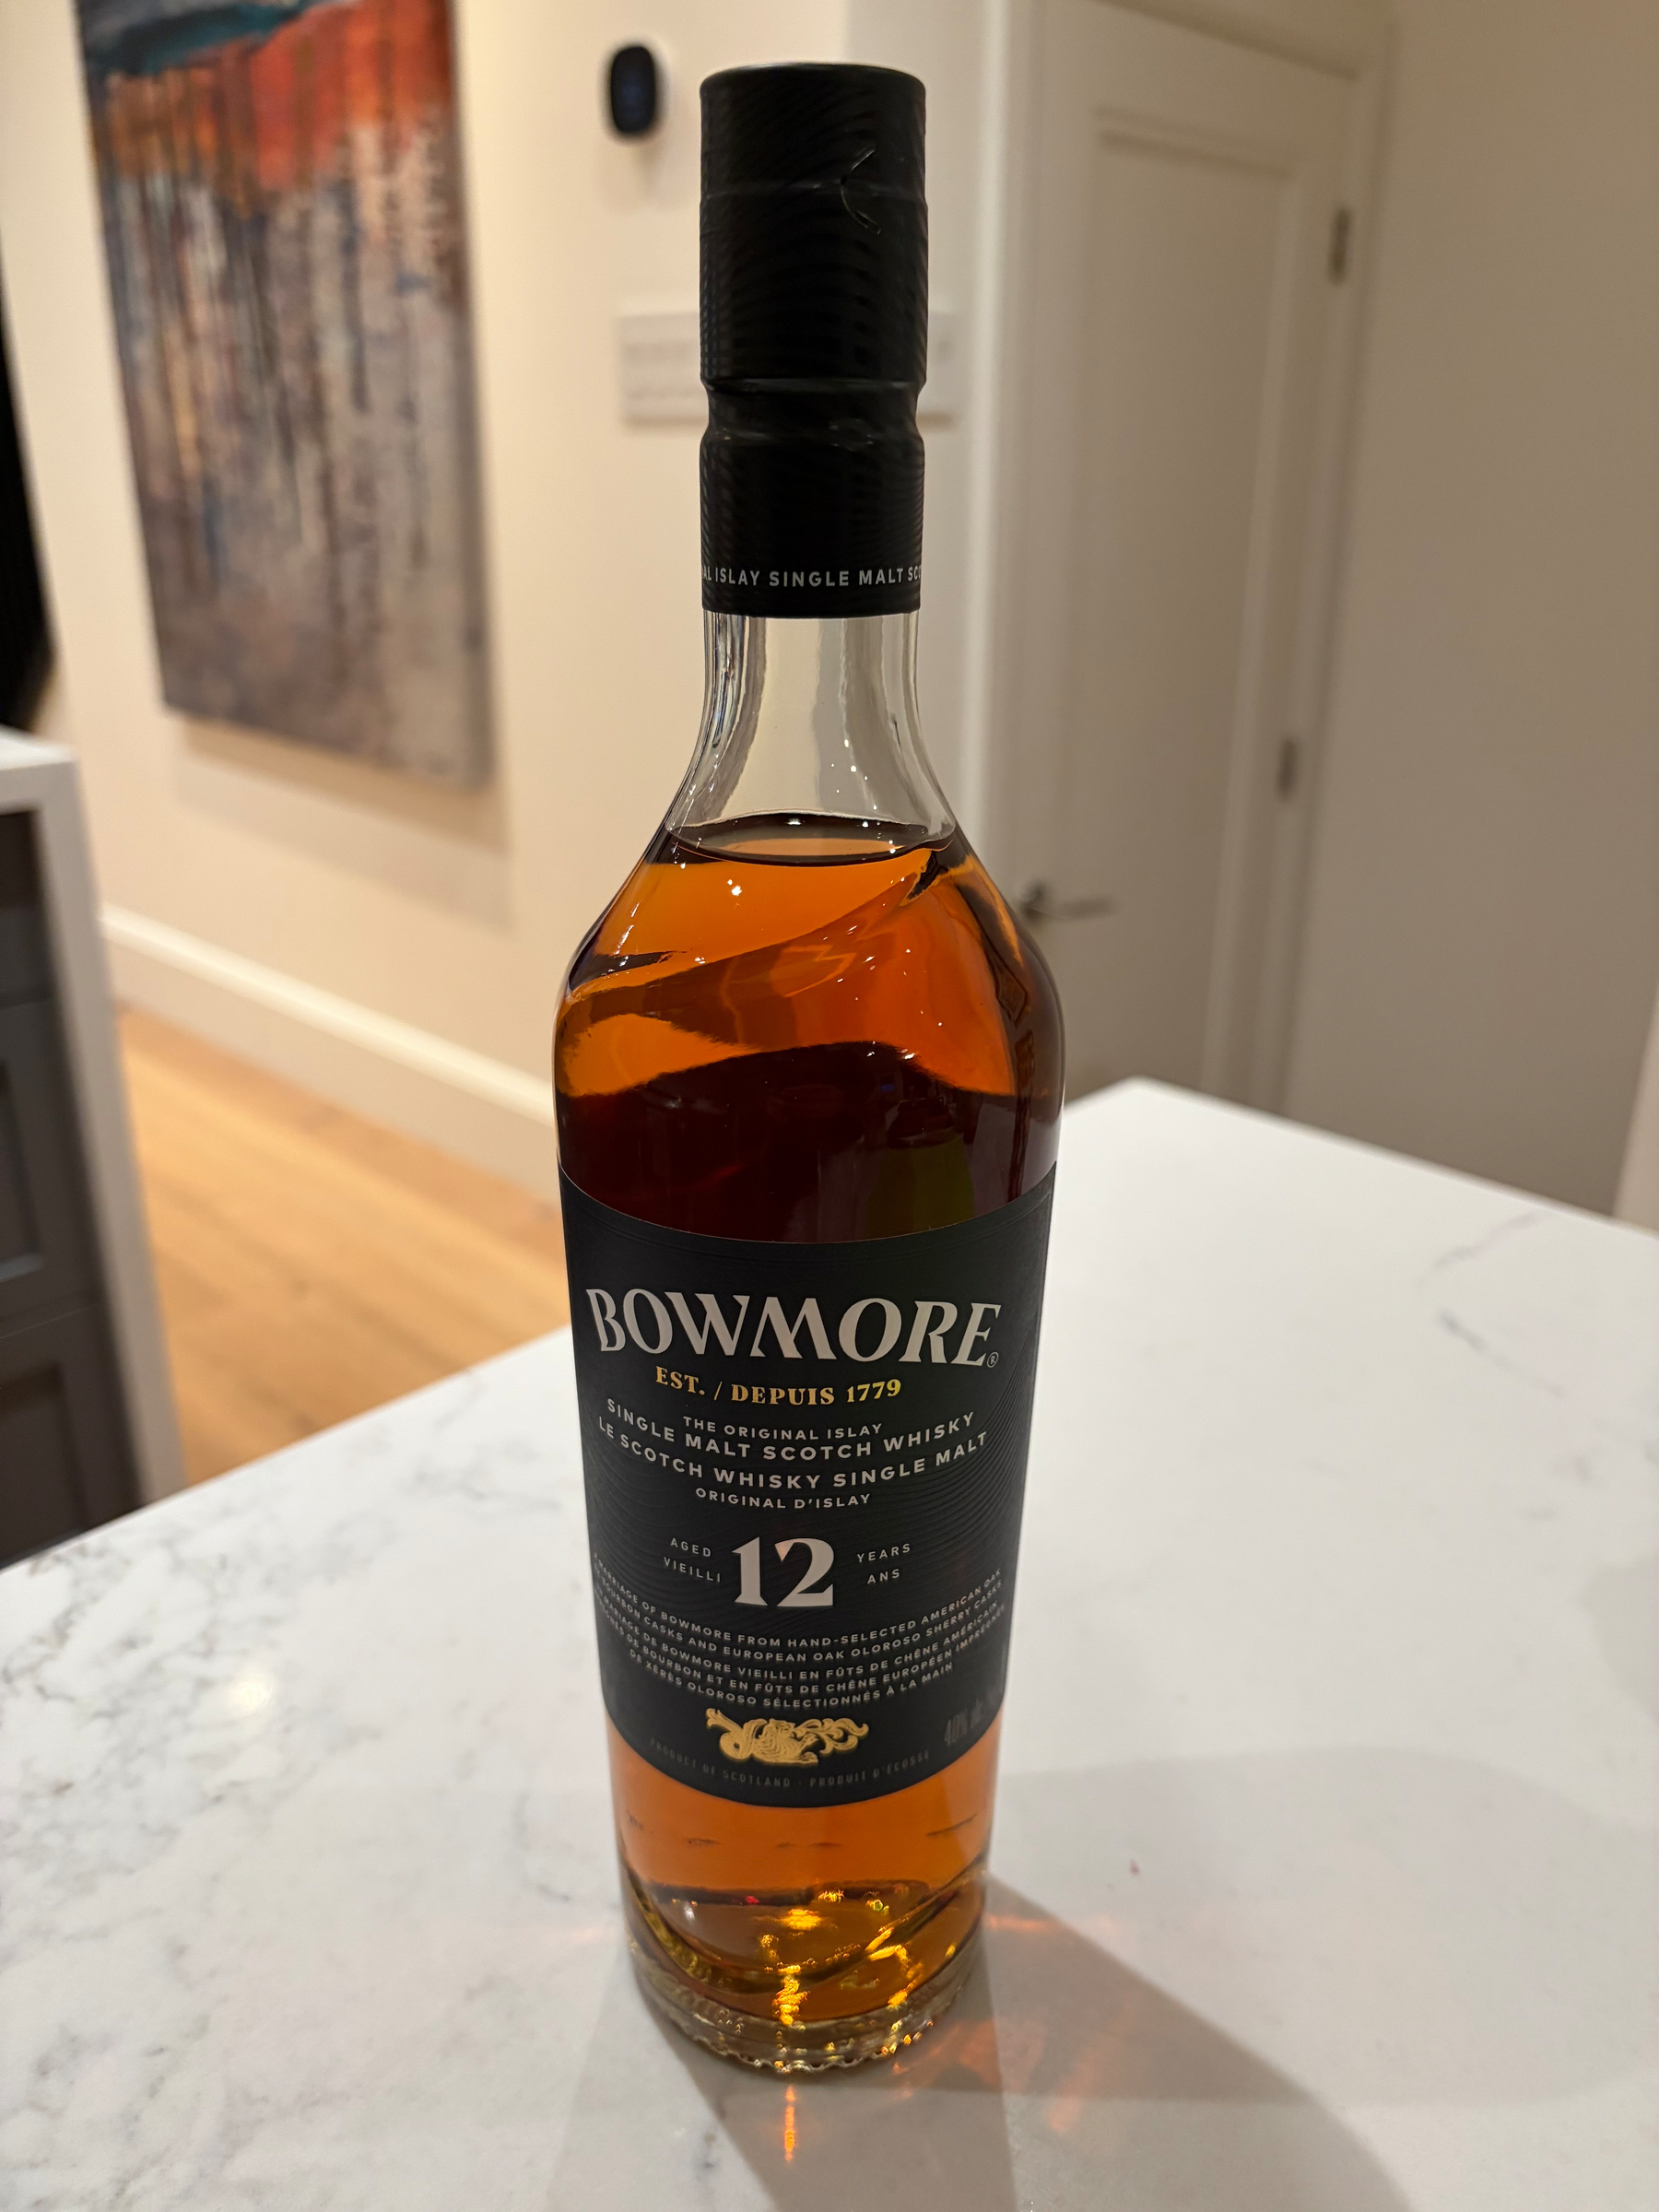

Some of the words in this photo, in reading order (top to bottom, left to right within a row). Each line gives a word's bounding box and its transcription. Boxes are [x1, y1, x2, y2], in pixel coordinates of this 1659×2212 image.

[715, 568, 760, 586] ISLAY
[770, 571, 849, 587] SINGLE
[859, 568, 904, 585] MALT
[655, 1365, 705, 1395] EST.
[731, 1383, 835, 1406] DEPUIS
[846, 1379, 901, 1403] 1779
[599, 1416, 615, 1440] LE
[620, 1433, 702, 1478] SCOTCH
[713, 1467, 820, 1489] WHISKY
[833, 1458, 925, 1488] SINGLE
[935, 1431, 987, 1466] MALT
[606, 1398, 675, 1443] SINGLE
[685, 1432, 750, 1458] MALT
[763, 1441, 871, 1462] SCOTCH
[883, 1411, 974, 1453] WHISKY
[683, 1416, 716, 1433] THE
[724, 1424, 818, 1441] ORIGINAL
[827, 1423, 882, 1440] ISLAY
[695, 1487, 786, 1509] ORIGINAL
[794, 1493, 870, 1509] D'ISLAY
[664, 1556, 721, 1583] VIEILLI
[670, 1537, 712, 1558] AGED
[732, 1536, 834, 1607] 12
[857, 1543, 911, 1564] YEARS
[867, 1569, 900, 1584] ANS
[641, 1601, 656, 1614] OF
[661, 1611, 731, 1641] BOWMORE
[737, 1634, 781, 1647] FROM
[787, 1620, 916, 1648] HAND-SELECTED
[921, 1585, 982, 1625] AMERICAN
[983, 1568, 1001, 1588] OAK
[644, 1616, 683, 1641] CASKS
[688, 1637, 717, 1652] AND
[723, 1646, 806, 1662] EUROPEAN
[813, 1650, 845, 1661] OAK
[851, 1632, 921, 1657] OLOROSO
[925, 1606, 971, 1637] SHERRY
[973, 1580, 1002, 1609] CASKS
[627, 1634, 639, 1648] DE
[642, 1645, 701, 1679] BOURBON
[707, 1675, 724, 1686] ET
[729, 1680, 748, 1691] EN
[755, 1683, 794, 1694] FÛTS
[800, 1686, 819, 1694] DE
[826, 1677, 877, 1693] CHÊNE
[882, 1649, 952, 1683] EUROPÉEN
[630, 1649, 642, 1664] DE
[645, 1660, 682, 1686] XÉRÈS
[688, 1682, 757, 1705] OLOROSO
[763, 1690, 881, 1708] SÉLECTIONNÉS
[886, 1685, 895, 1697] À
[900, 1679, 917, 1692] LA
[922, 1662, 953, 1685] MAIN
[643, 1632, 657, 1646] DE
[662, 1642, 731, 1672] BOWMORE
[737, 1666, 793, 1680] VIEILLI
[799, 1671, 819, 1680] EN
[826, 1666, 864, 1678] FÛTS
[870, 1660, 888, 1672] DE
[894, 1642, 938, 1665] CHÊNE
[650, 1738, 698, 1769] PRODUCT
[702, 1763, 716, 1775] OF
[723, 1770, 792, 1788] SCOTLAND
